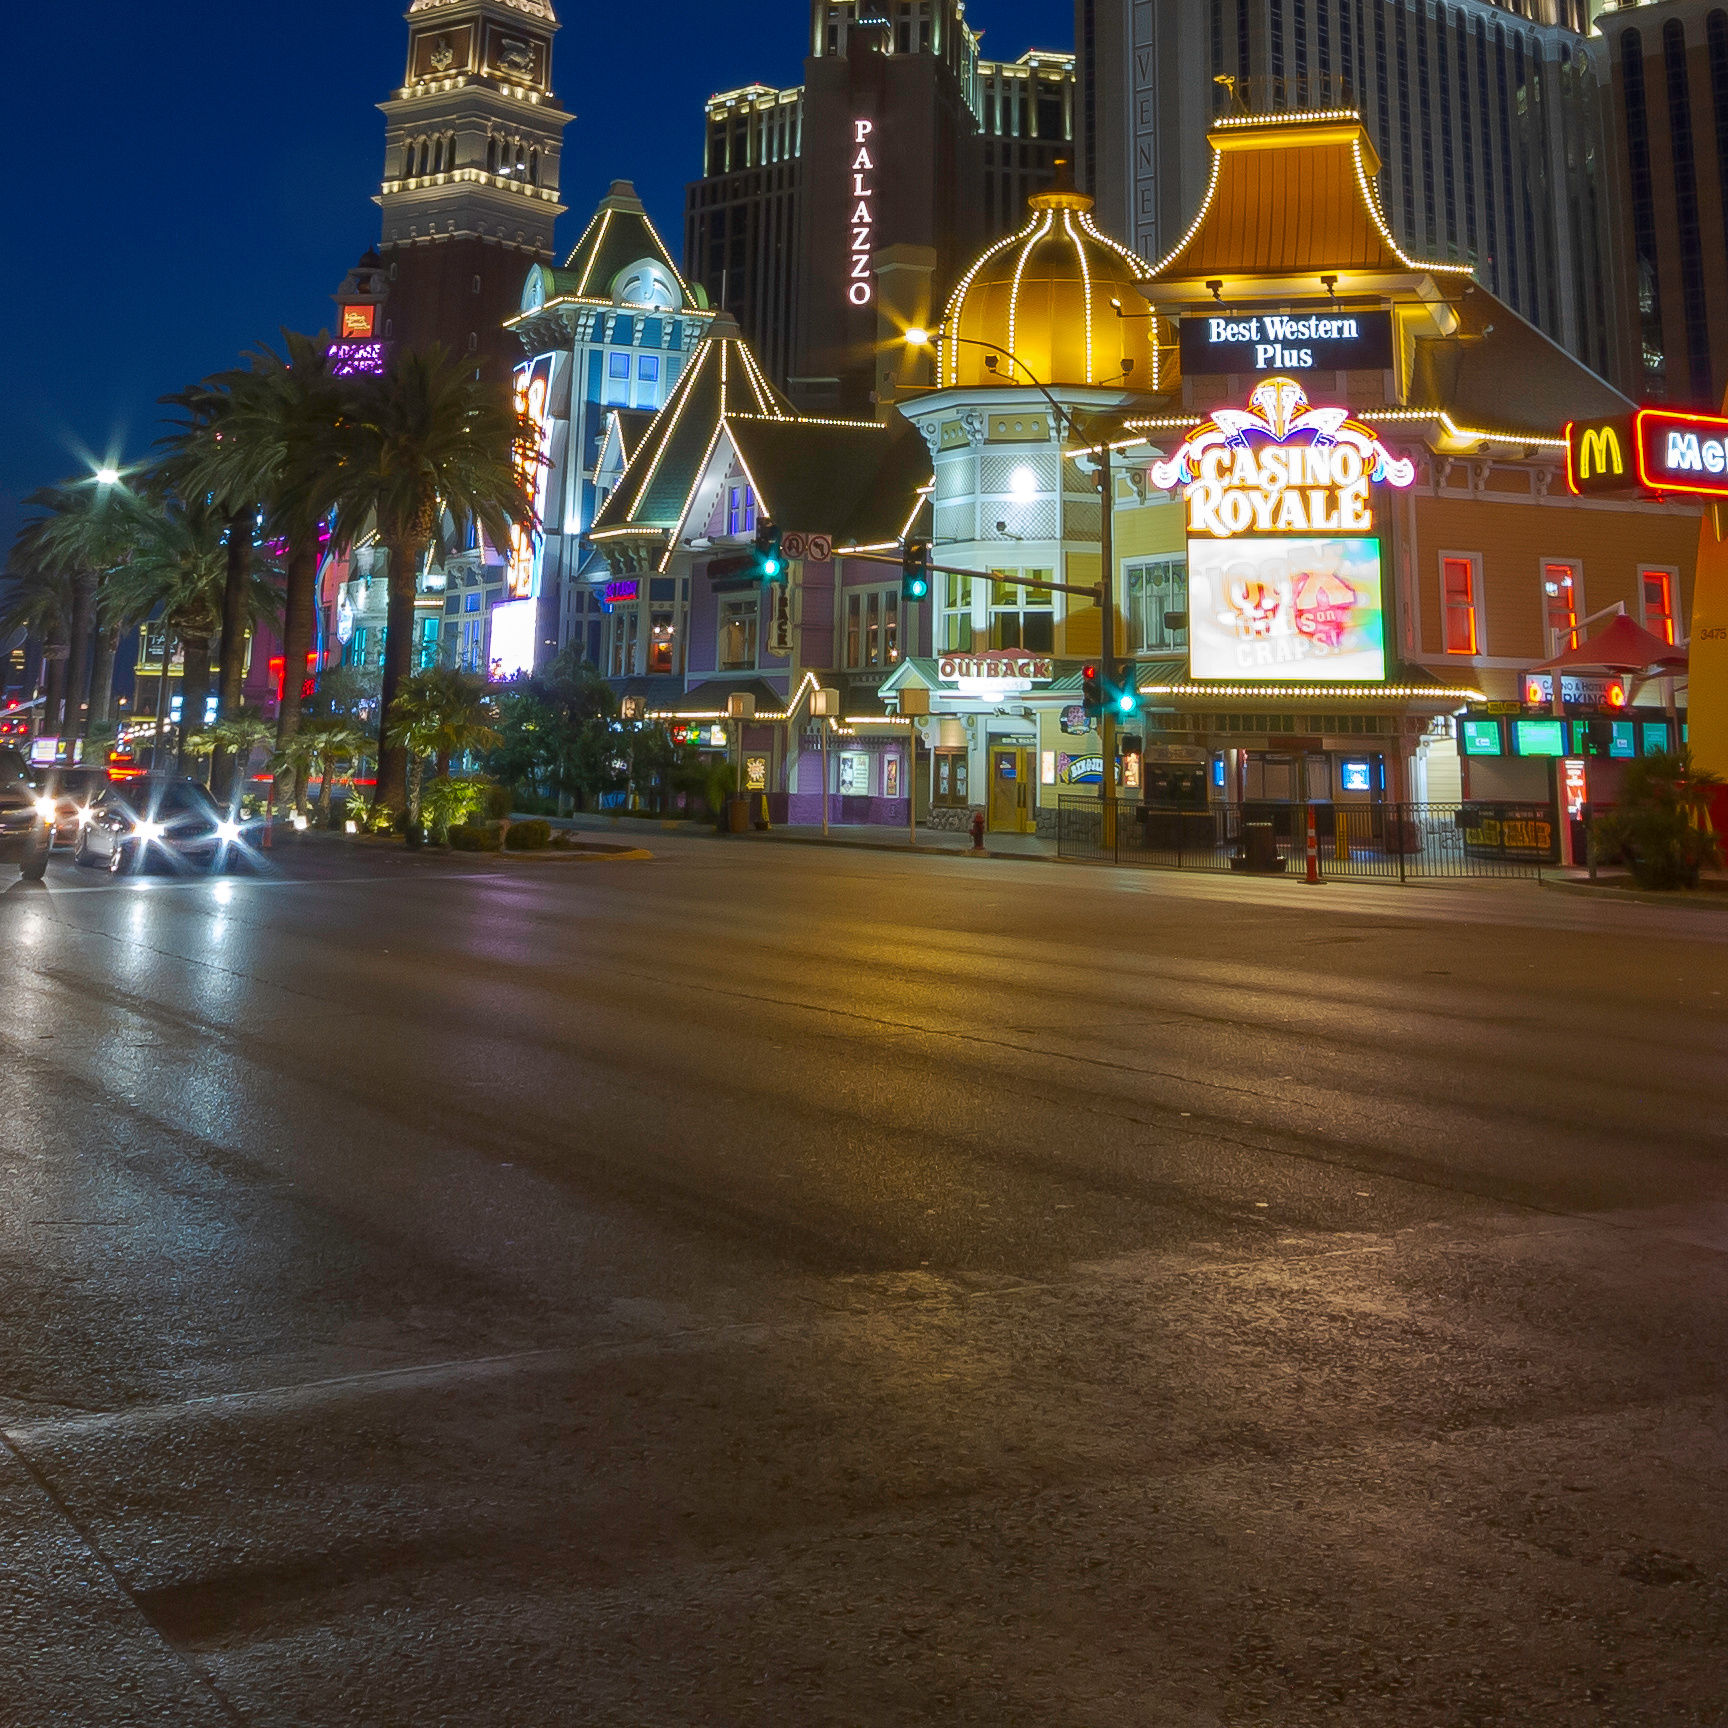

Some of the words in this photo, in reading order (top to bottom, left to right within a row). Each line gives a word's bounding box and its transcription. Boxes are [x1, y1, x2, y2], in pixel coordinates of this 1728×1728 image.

[849, 120, 874, 305] PALAZZO
[1208, 318, 1260, 343] Best
[1263, 316, 1359, 341] Western
[1255, 344, 1313, 369] Plus
[1200, 445, 1362, 491] CASINO
[1184, 477, 1372, 537] ROYALE
[1700, 628, 1727, 641] 3475
[940, 658, 1051, 679] OUTBACK
[1542, 680, 1574, 691] CANO
[1545, 691, 1610, 704] PRKING
